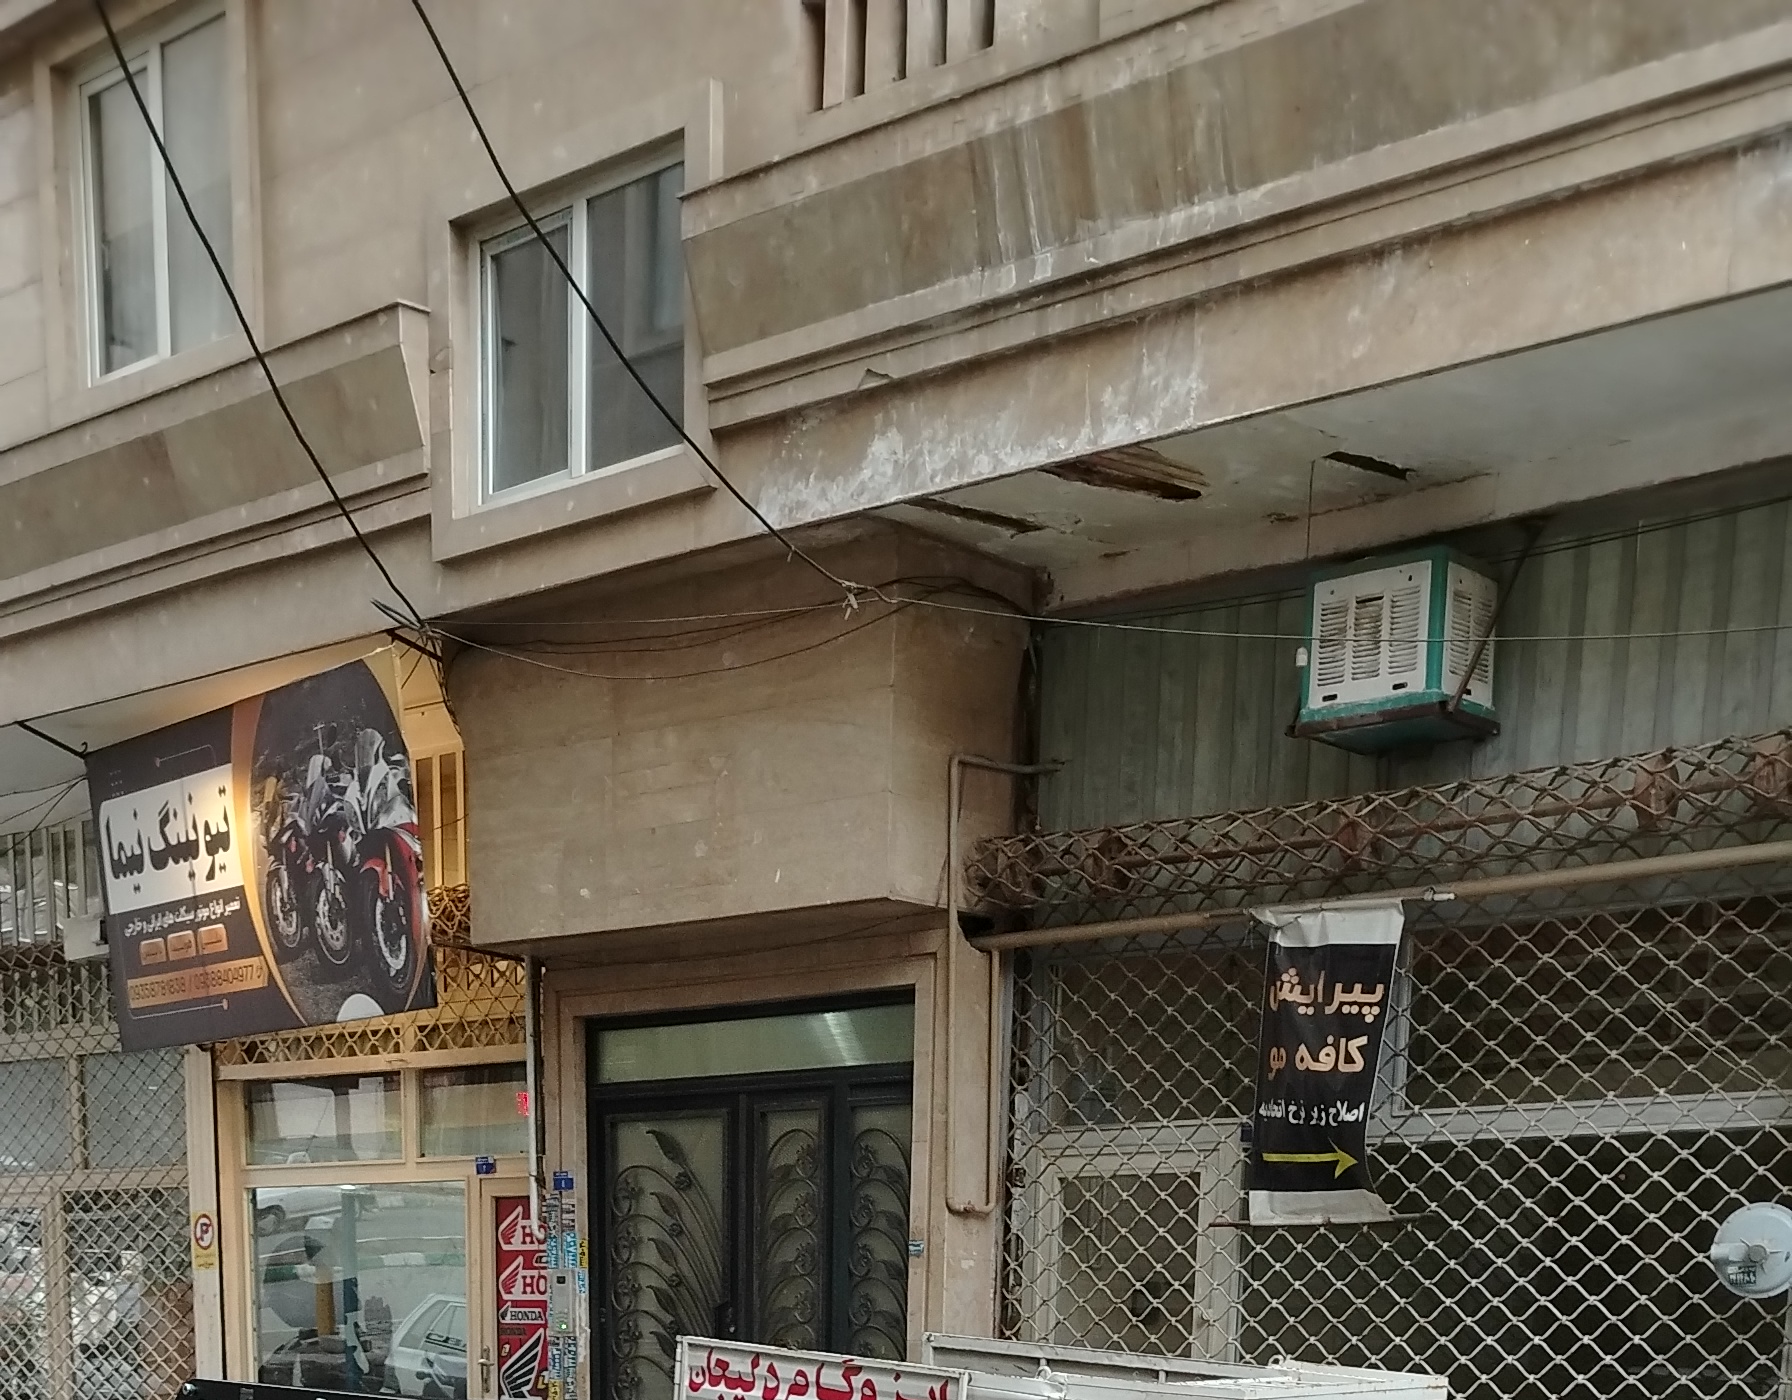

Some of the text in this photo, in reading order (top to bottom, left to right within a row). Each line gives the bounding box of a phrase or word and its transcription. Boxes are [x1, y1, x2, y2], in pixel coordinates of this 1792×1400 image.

[106, 808, 146, 894] نیما
[1269, 967, 1385, 1023] پیرایش
[1294, 1034, 1368, 1074] کافه
[1328, 1100, 1365, 1127] اصلاح
[510, 1310, 543, 1322] HONDA
